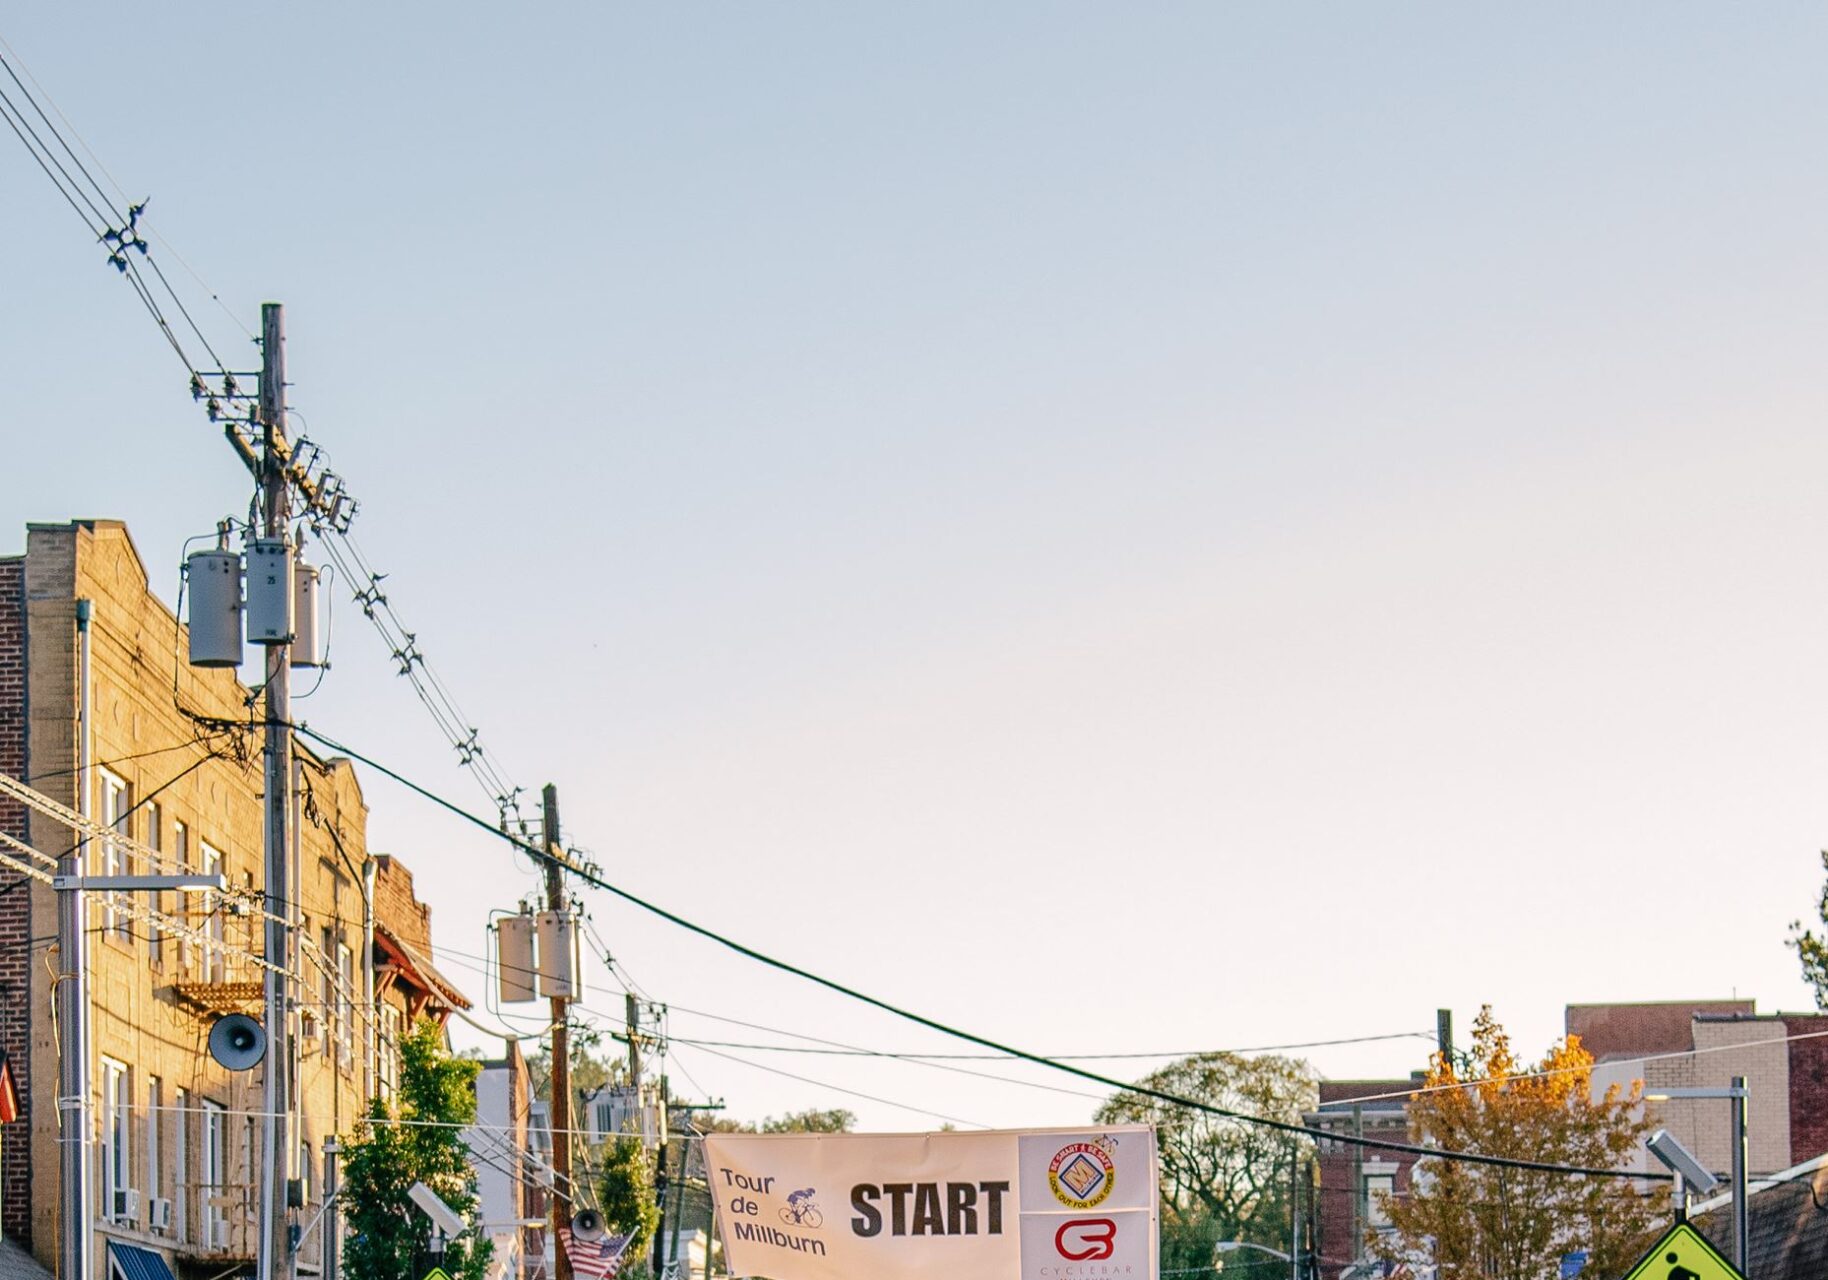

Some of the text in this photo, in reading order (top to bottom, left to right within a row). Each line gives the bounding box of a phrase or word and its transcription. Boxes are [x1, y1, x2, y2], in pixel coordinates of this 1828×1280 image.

[720, 1168, 775, 1194] Tour
[730, 1196, 758, 1216] de
[850, 1181, 1010, 1237] START
[1058, 1194, 1073, 1207] OUT
[1073, 1201, 1088, 1209] FOR
[734, 1222, 826, 1256] Millburn
[1040, 1266, 1132, 1276] CYCLEBAR
